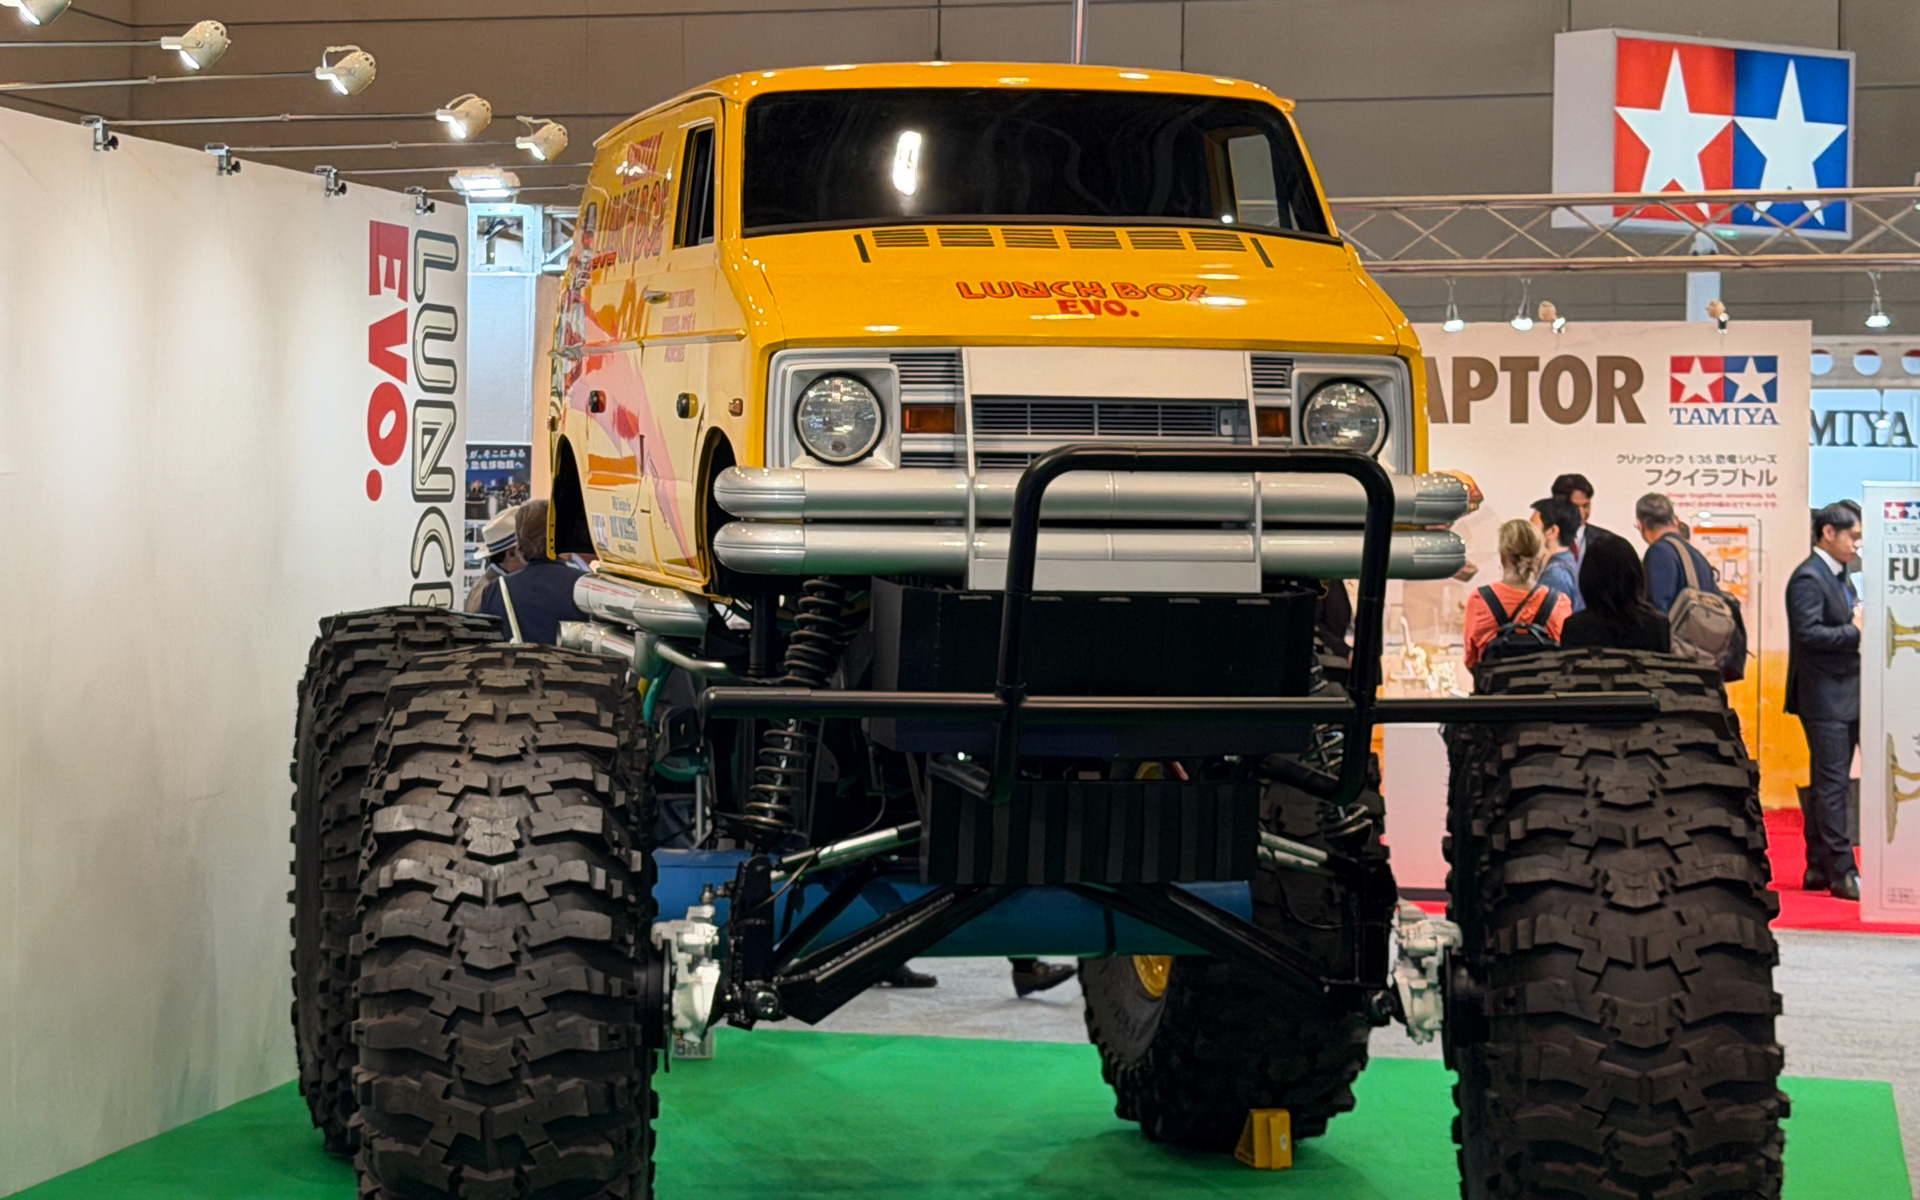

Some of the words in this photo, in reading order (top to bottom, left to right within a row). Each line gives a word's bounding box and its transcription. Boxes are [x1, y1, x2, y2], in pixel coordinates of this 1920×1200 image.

[956, 281, 1107, 299] LUNCH
[1112, 282, 1207, 301] BOX
[1056, 299, 1140, 317] EVO.
[366, 220, 409, 501] EVO.
[1669, 407, 1780, 425] TAMIYA
[1645, 468, 1778, 487] フクイラブトル
